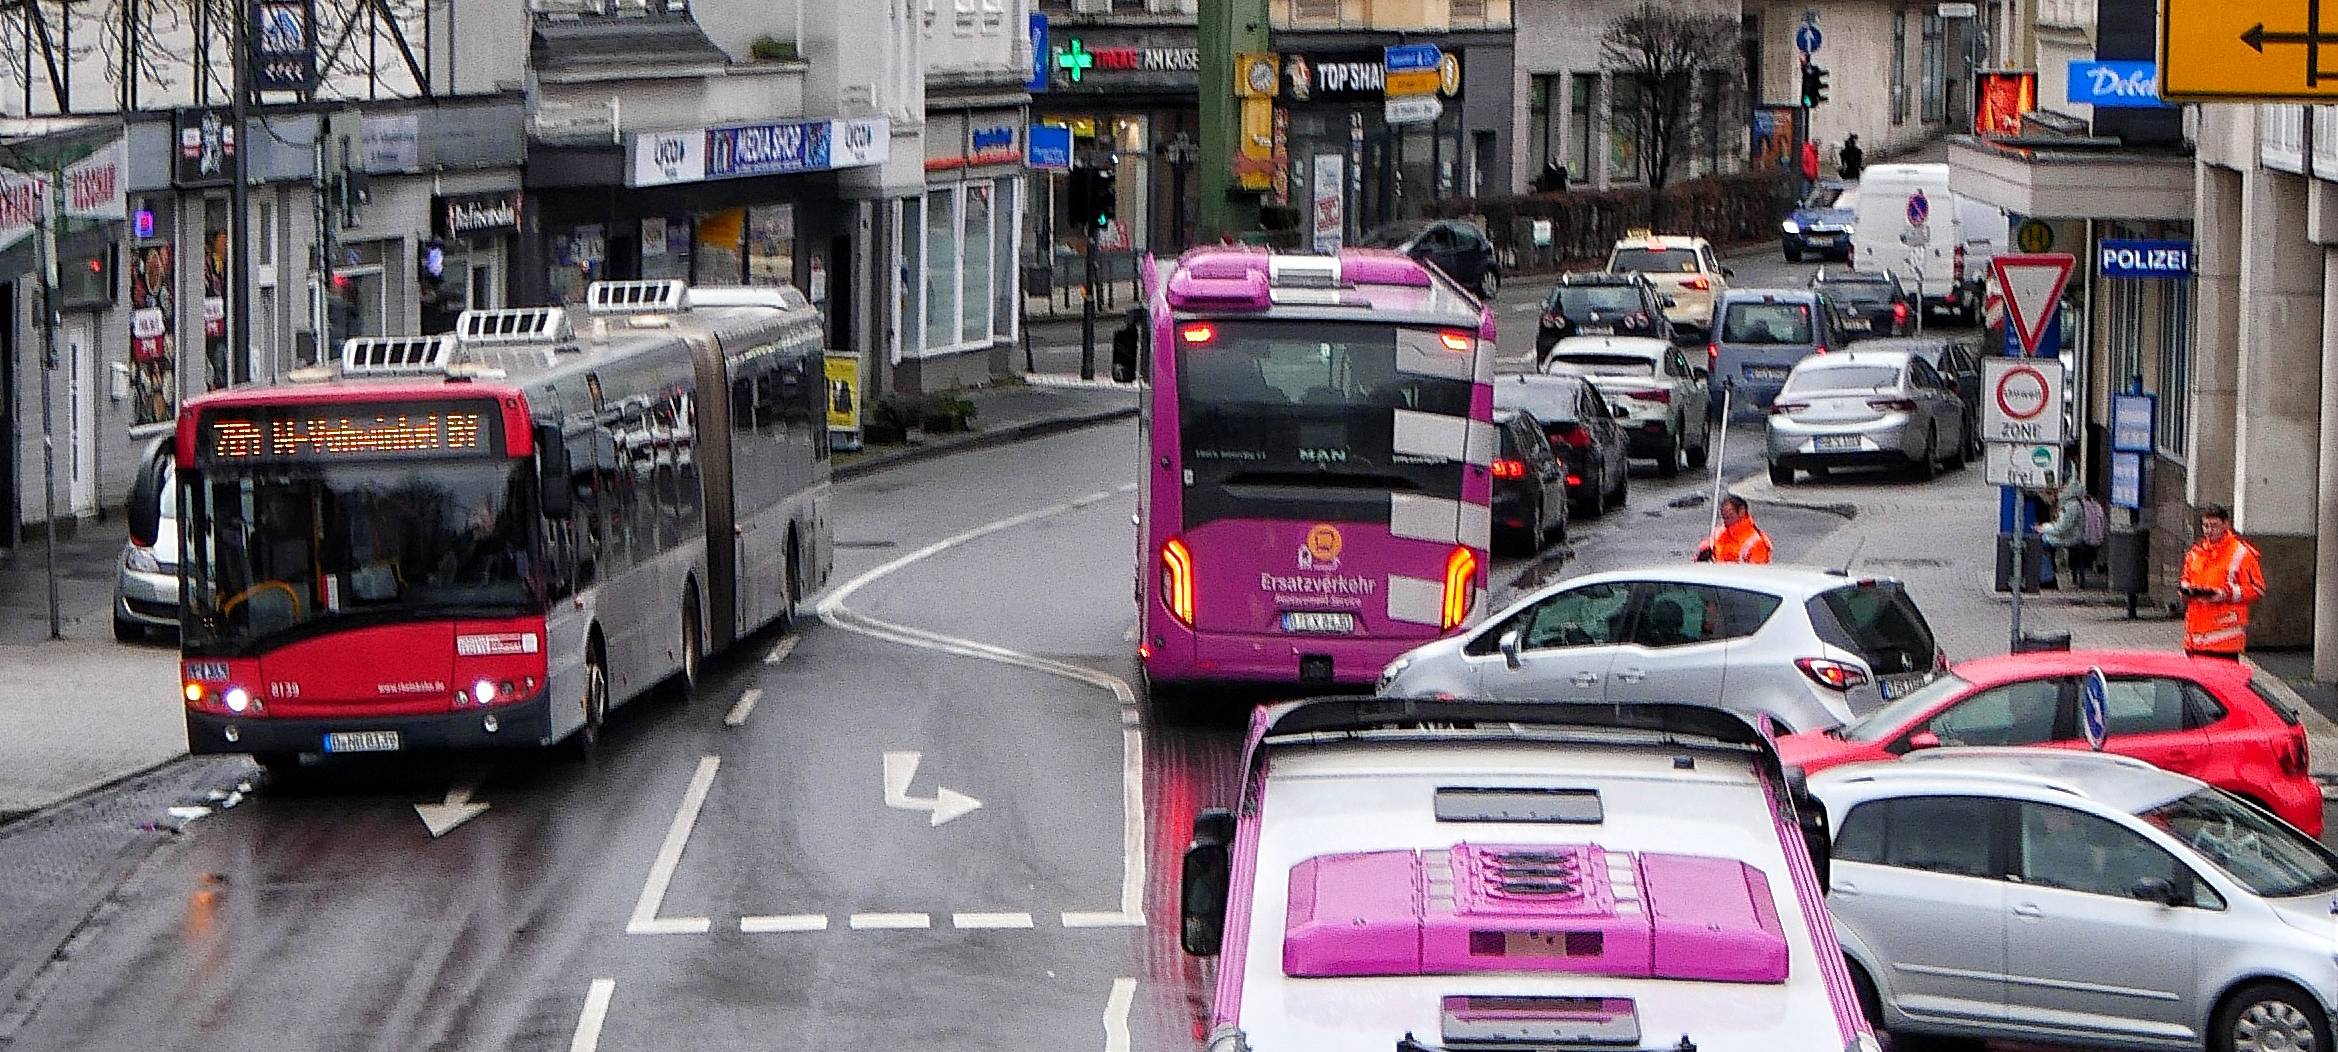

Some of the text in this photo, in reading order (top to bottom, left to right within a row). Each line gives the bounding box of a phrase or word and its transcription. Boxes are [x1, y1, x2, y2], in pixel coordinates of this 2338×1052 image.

[1144, 49, 1163, 70] AN
[1164, 48, 1199, 70] KAISE
[1317, 63, 1349, 92] TOP
[737, 124, 801, 164] MEDIA SHOP
[2103, 249, 2187, 271] POLIZEI
[2001, 422, 2041, 440] ZONE
[1300, 448, 1346, 462] MAN
[1261, 572, 1377, 595] Ersatzverkehr
[271, 681, 300, 698] 8139
